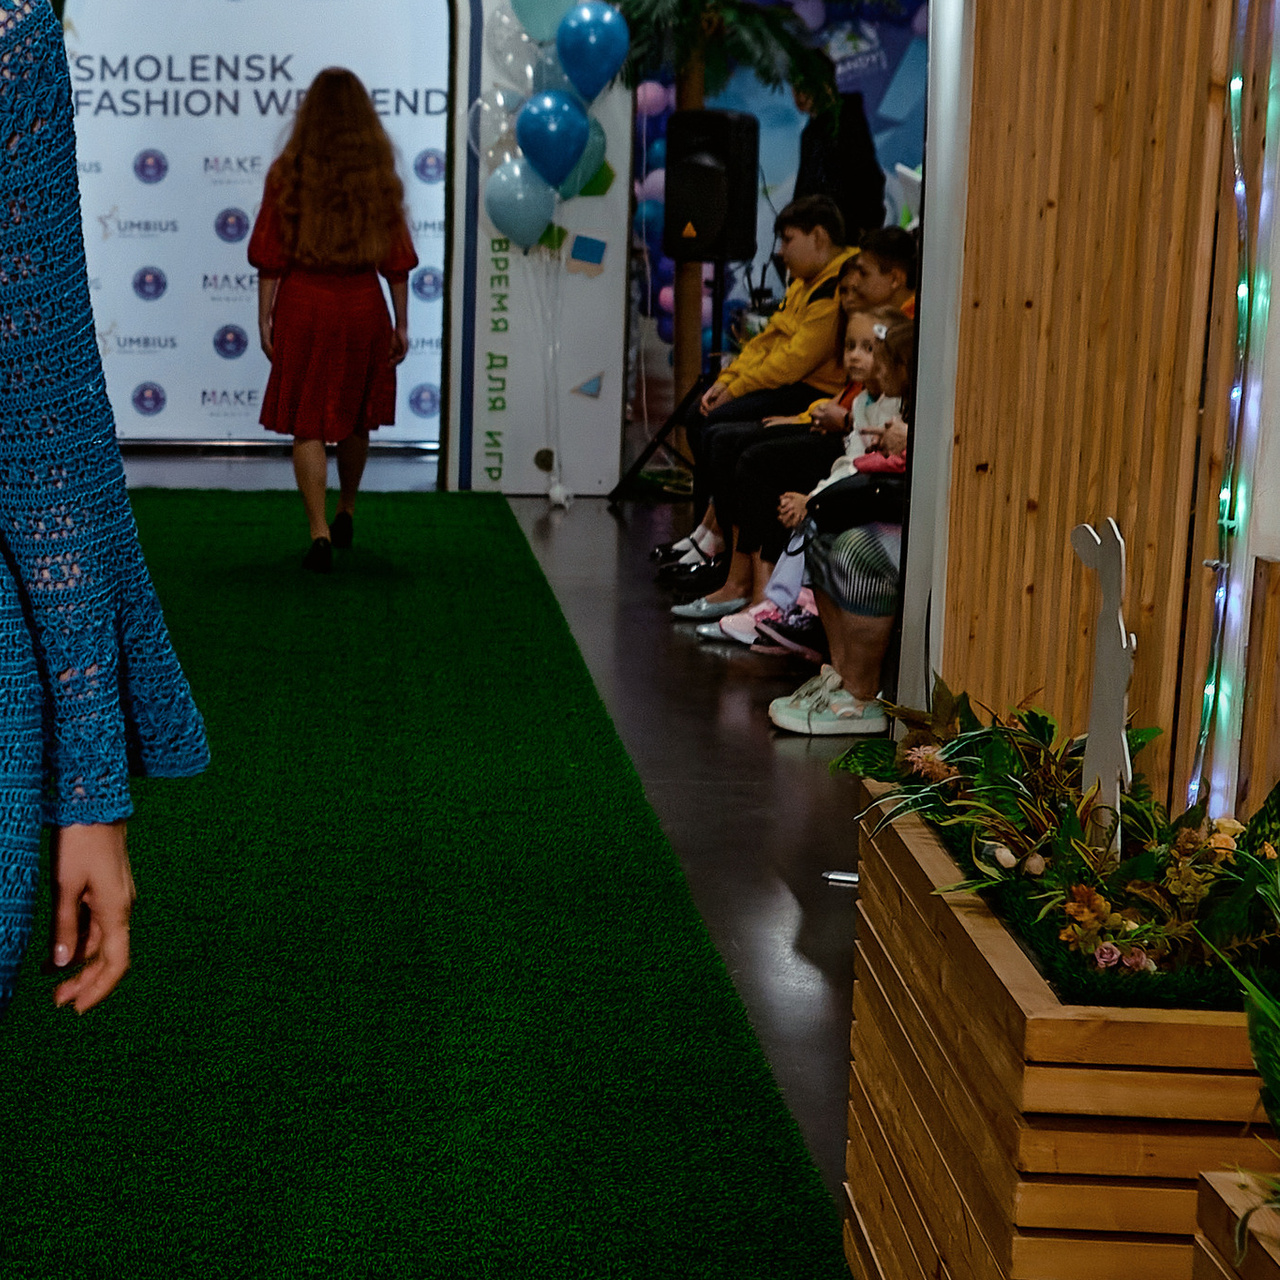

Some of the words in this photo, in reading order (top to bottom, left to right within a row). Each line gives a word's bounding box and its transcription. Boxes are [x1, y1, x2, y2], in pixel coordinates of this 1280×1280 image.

[74, 53, 294, 83] SMOLENSK
[74, 88, 241, 117] FASHION
[253, 88, 449, 117] WEND
[117, 220, 179, 233] UMBIUS
[489, 237, 511, 333] ВРЕМЯ
[117, 336, 178, 349] UMBIUS
[486, 351, 508, 412] ДЛЯ
[202, 389, 260, 407] MAKE
[484, 430, 504, 483] ИГР
